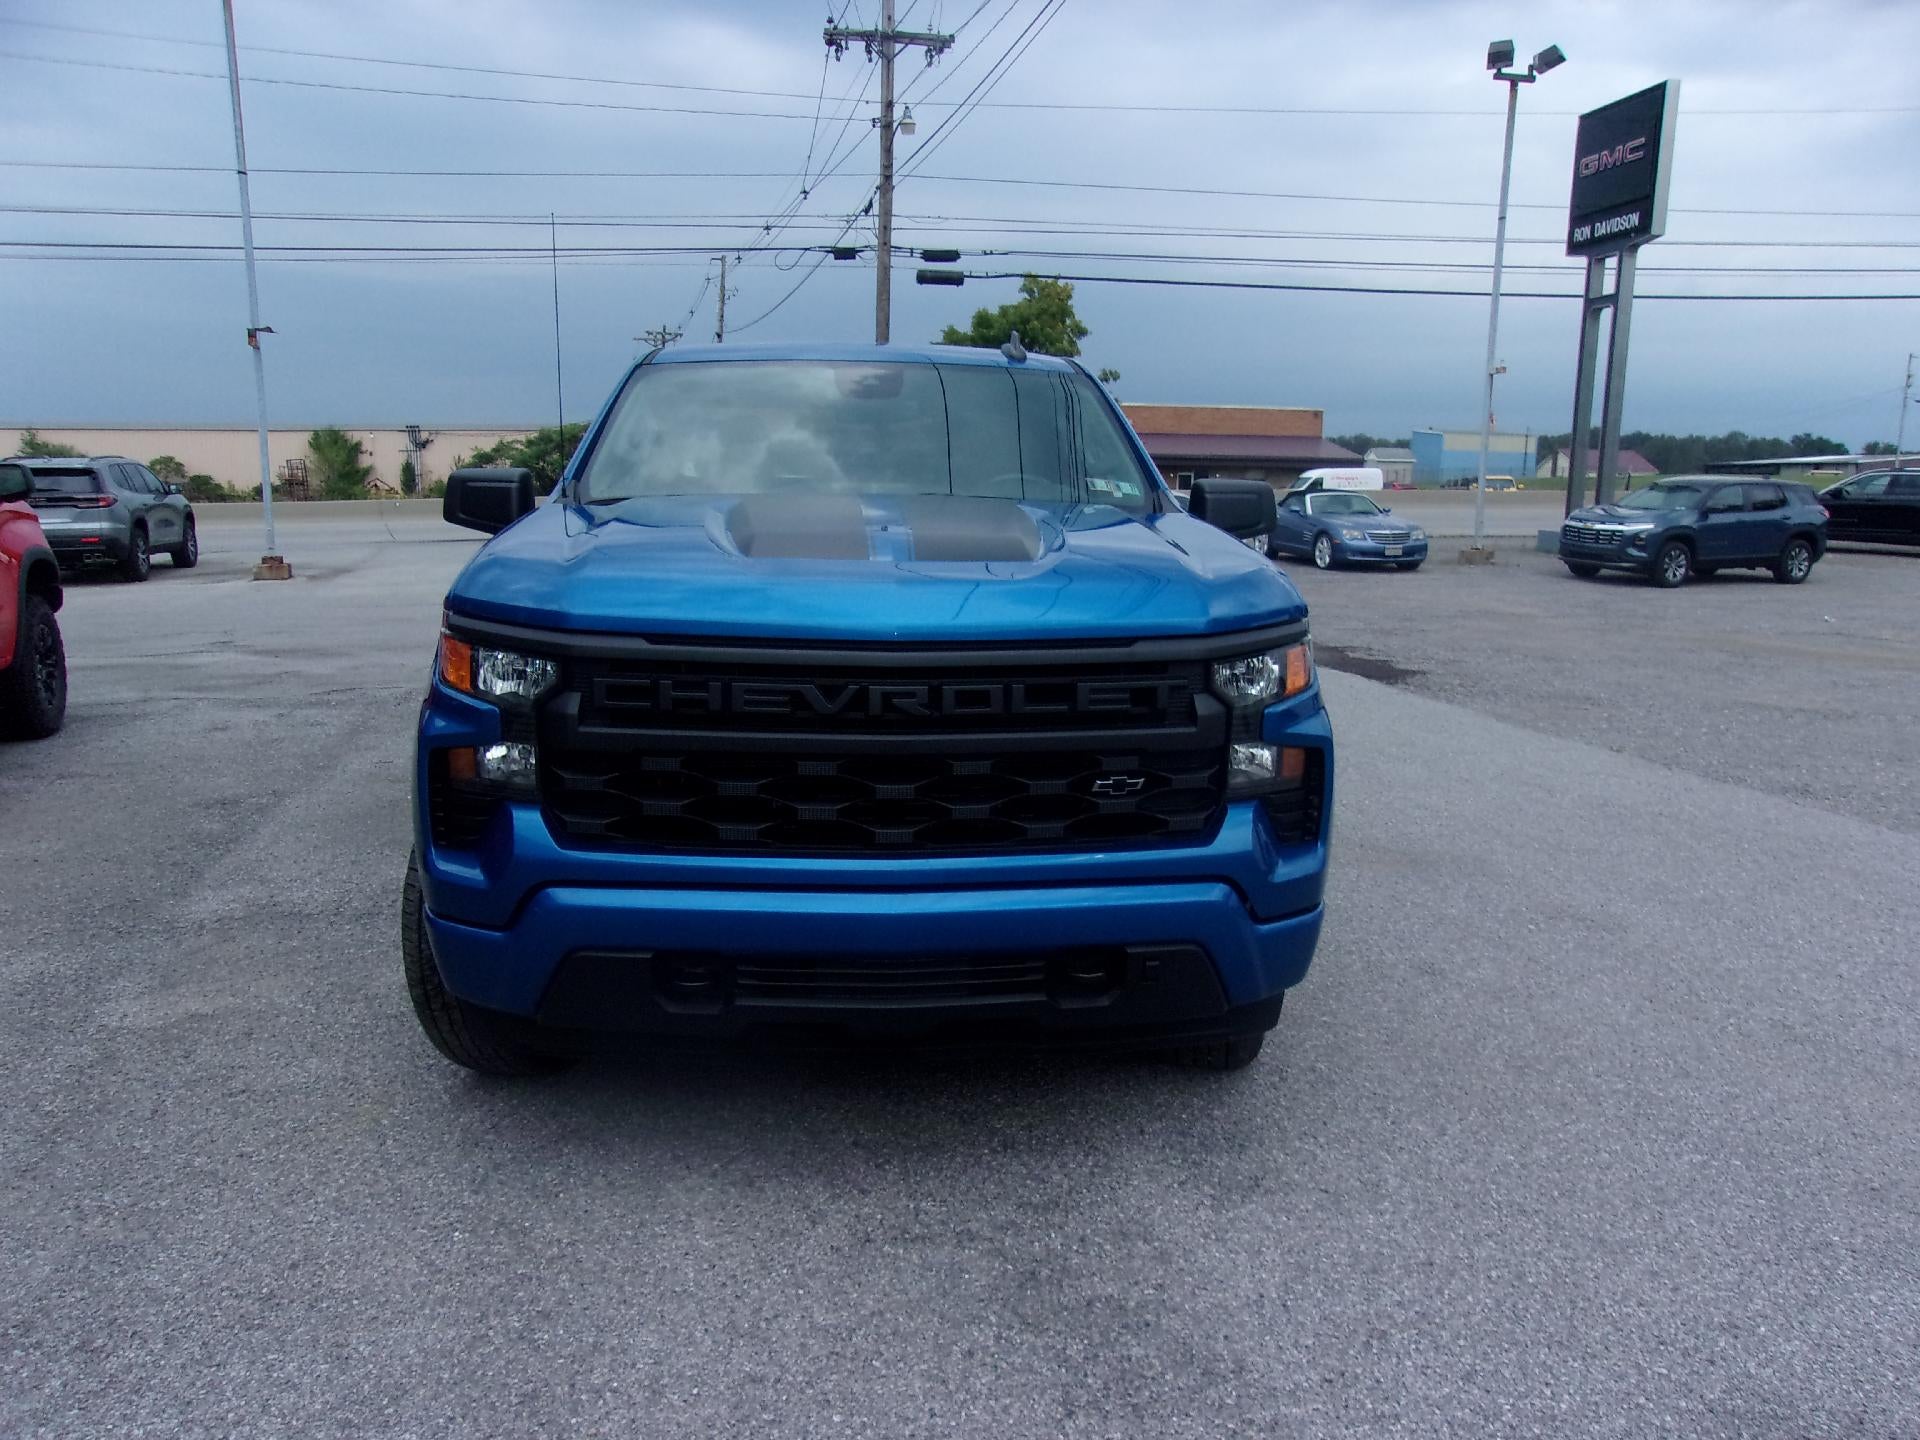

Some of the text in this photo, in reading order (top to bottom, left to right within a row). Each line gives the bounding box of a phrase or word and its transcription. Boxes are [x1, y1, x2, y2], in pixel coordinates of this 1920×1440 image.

[1580, 138, 1645, 177] GMC
[1574, 212, 1640, 242] RON DAVIDSON
[593, 677, 1188, 714] CHEVROLET
